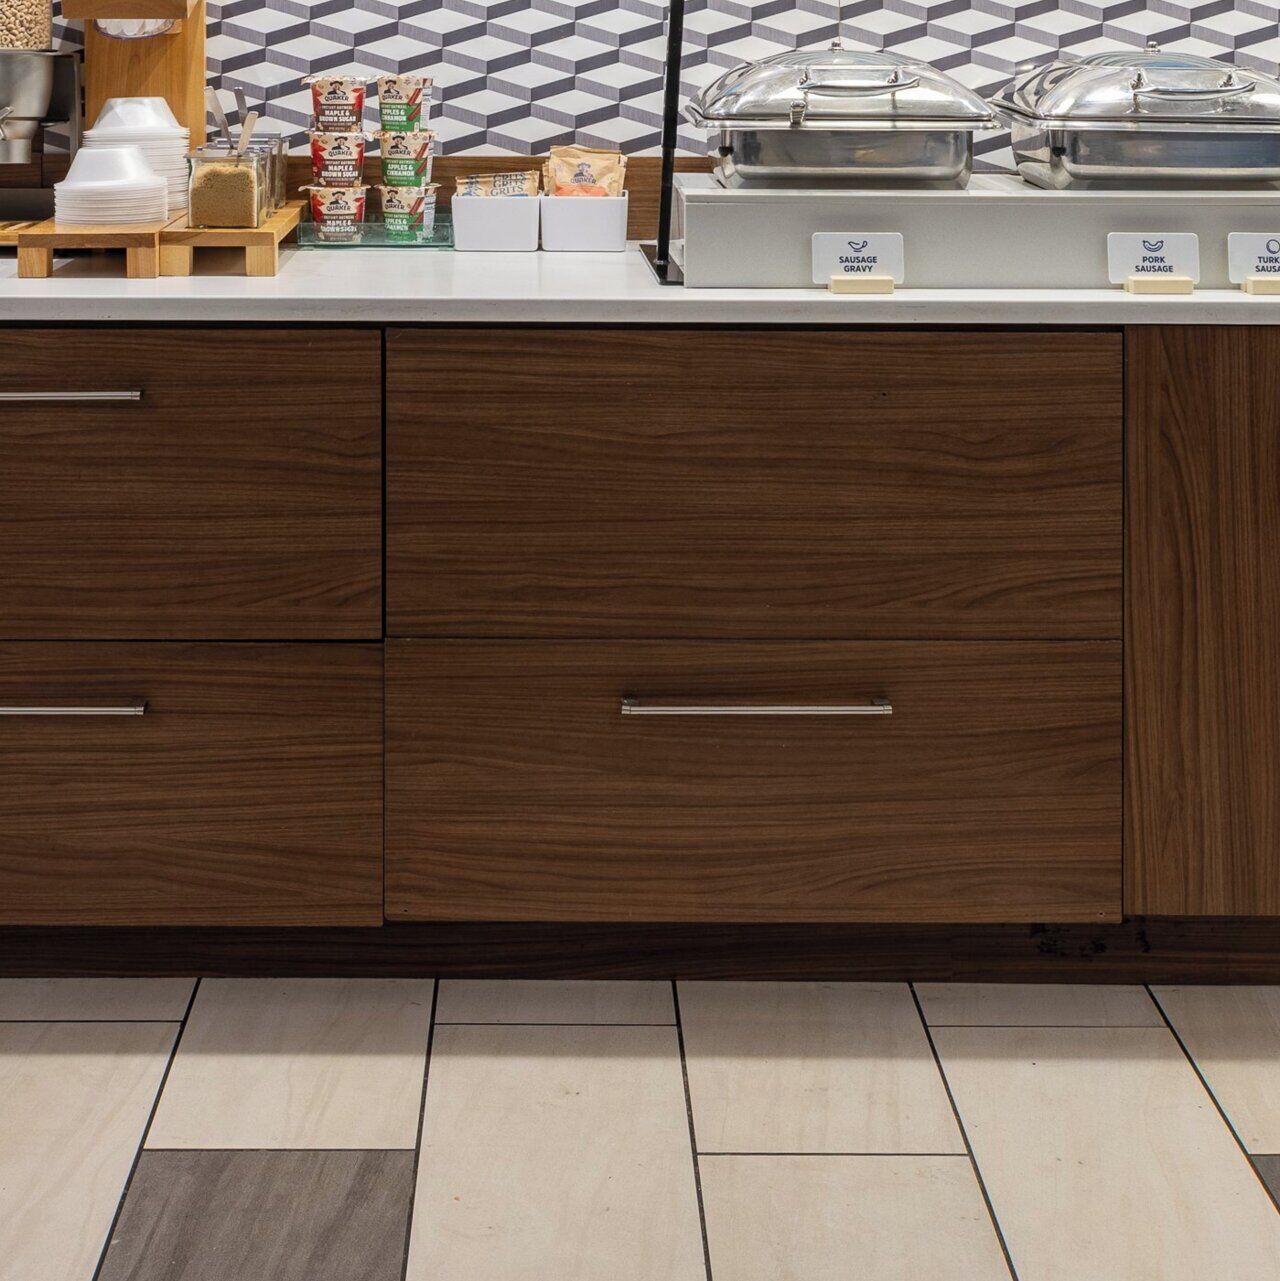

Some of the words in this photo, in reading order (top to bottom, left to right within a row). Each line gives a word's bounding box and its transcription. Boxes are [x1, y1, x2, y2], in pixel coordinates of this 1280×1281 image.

[388, 164, 408, 172] APPLES
[571, 176, 596, 184] QUAKER
[490, 184, 524, 197] GRITS
[839, 256, 878, 264] SAUSAGE
[1142, 256, 1166, 264] PORK
[843, 265, 873, 273] GRAVY
[1135, 265, 1174, 273] SAUSAGE
